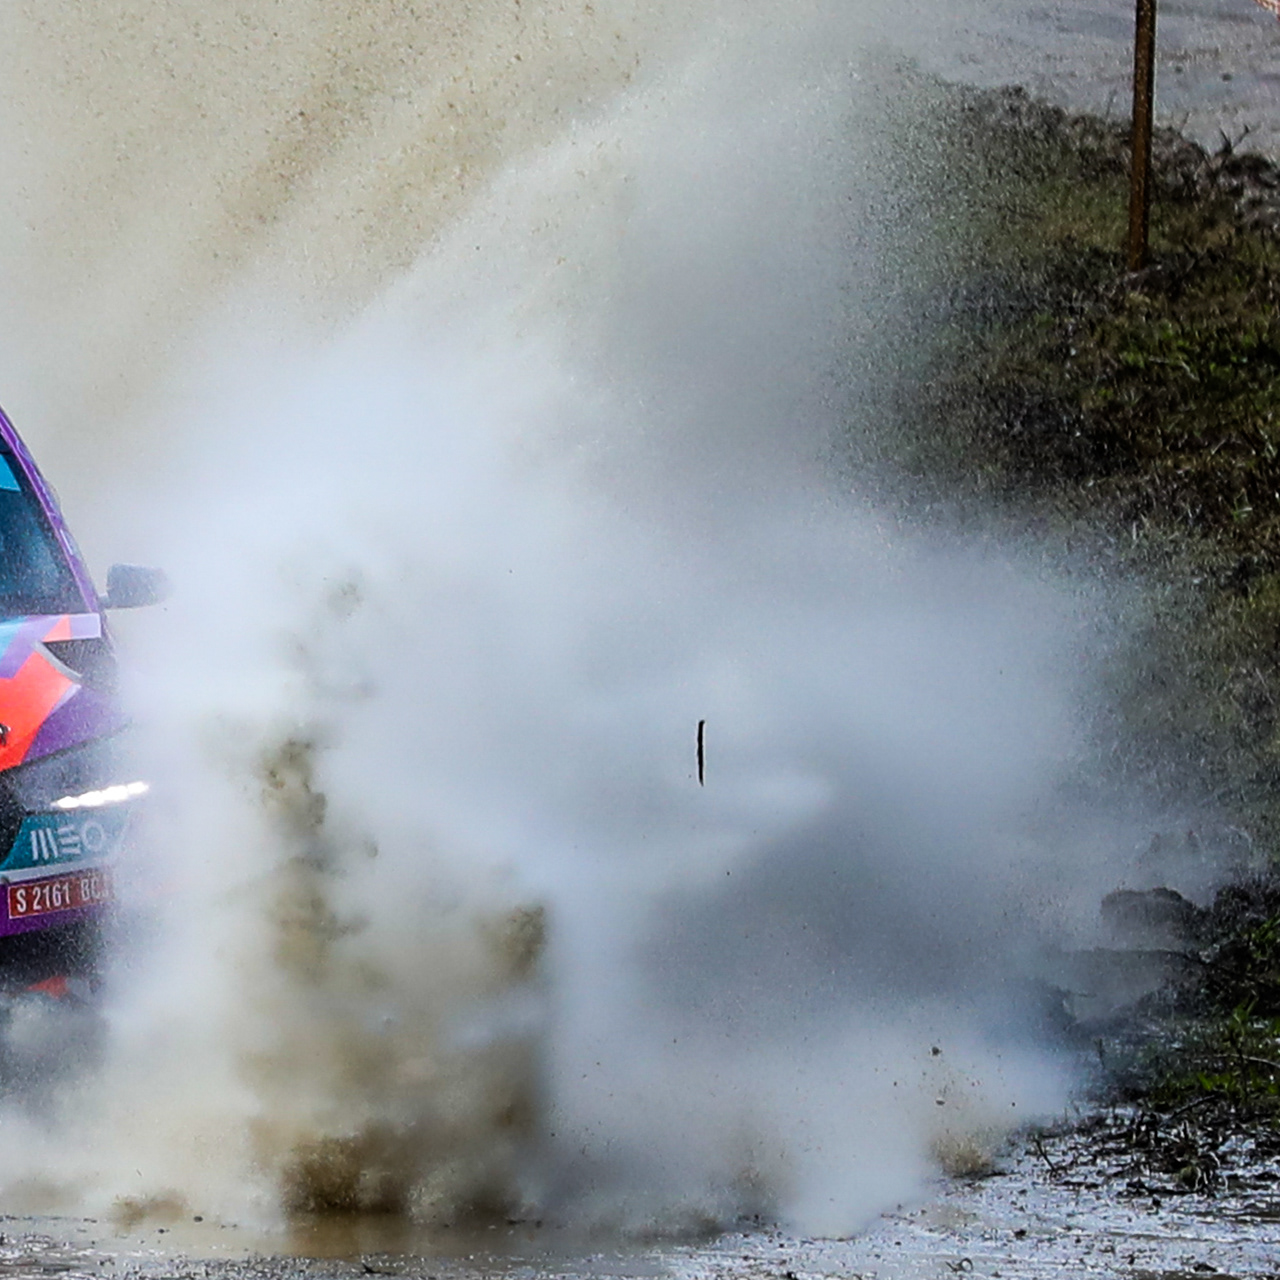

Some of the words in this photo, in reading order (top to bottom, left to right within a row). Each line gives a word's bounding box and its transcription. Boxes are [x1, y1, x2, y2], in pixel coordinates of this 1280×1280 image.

[30, 821, 105, 861] MEO
[15, 888, 28, 913] S
[32, 882, 71, 911] 2161
